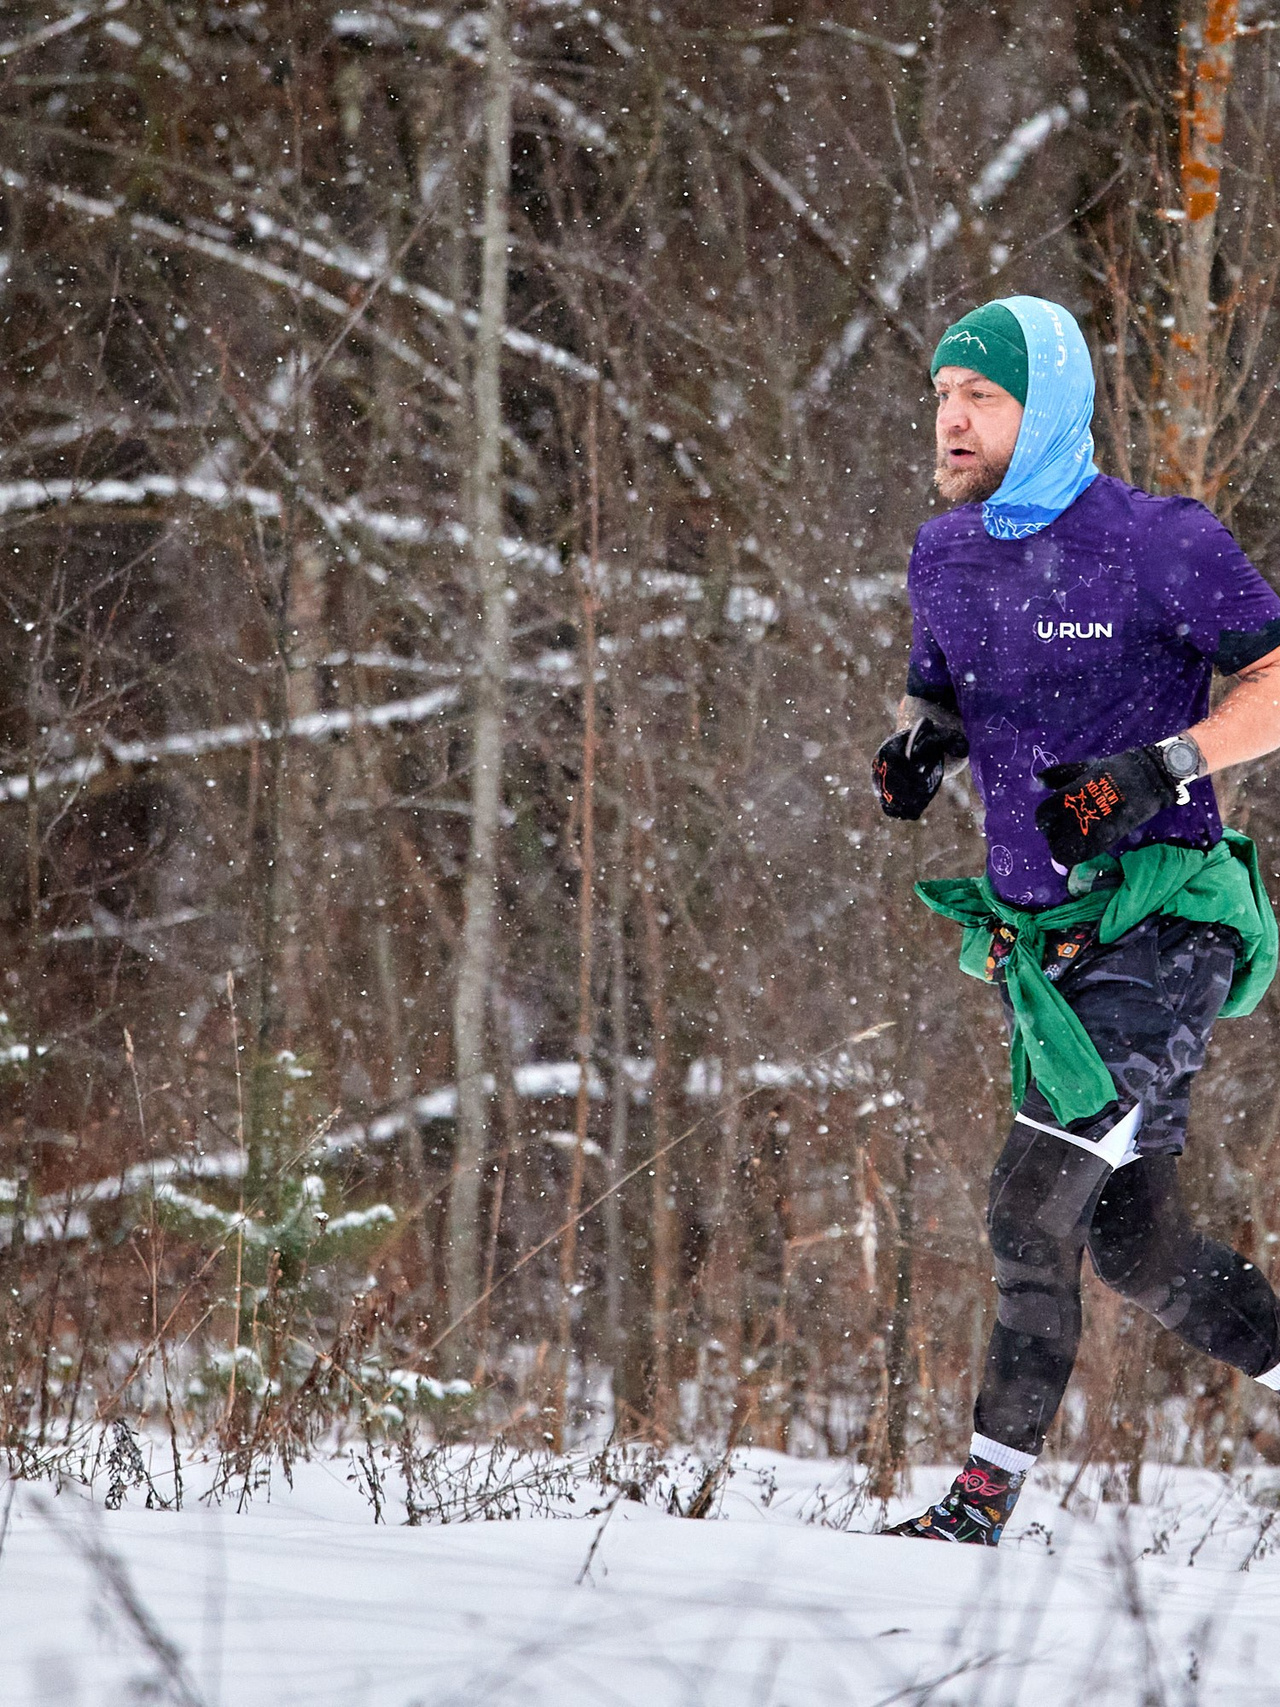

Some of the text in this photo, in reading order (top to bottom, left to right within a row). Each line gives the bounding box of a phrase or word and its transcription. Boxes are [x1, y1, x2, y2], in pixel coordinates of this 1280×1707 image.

[1059, 622, 1113, 639] RUN
[1084, 779, 1112, 817] MAD FOX
[1098, 777, 1119, 806] ULTRA
